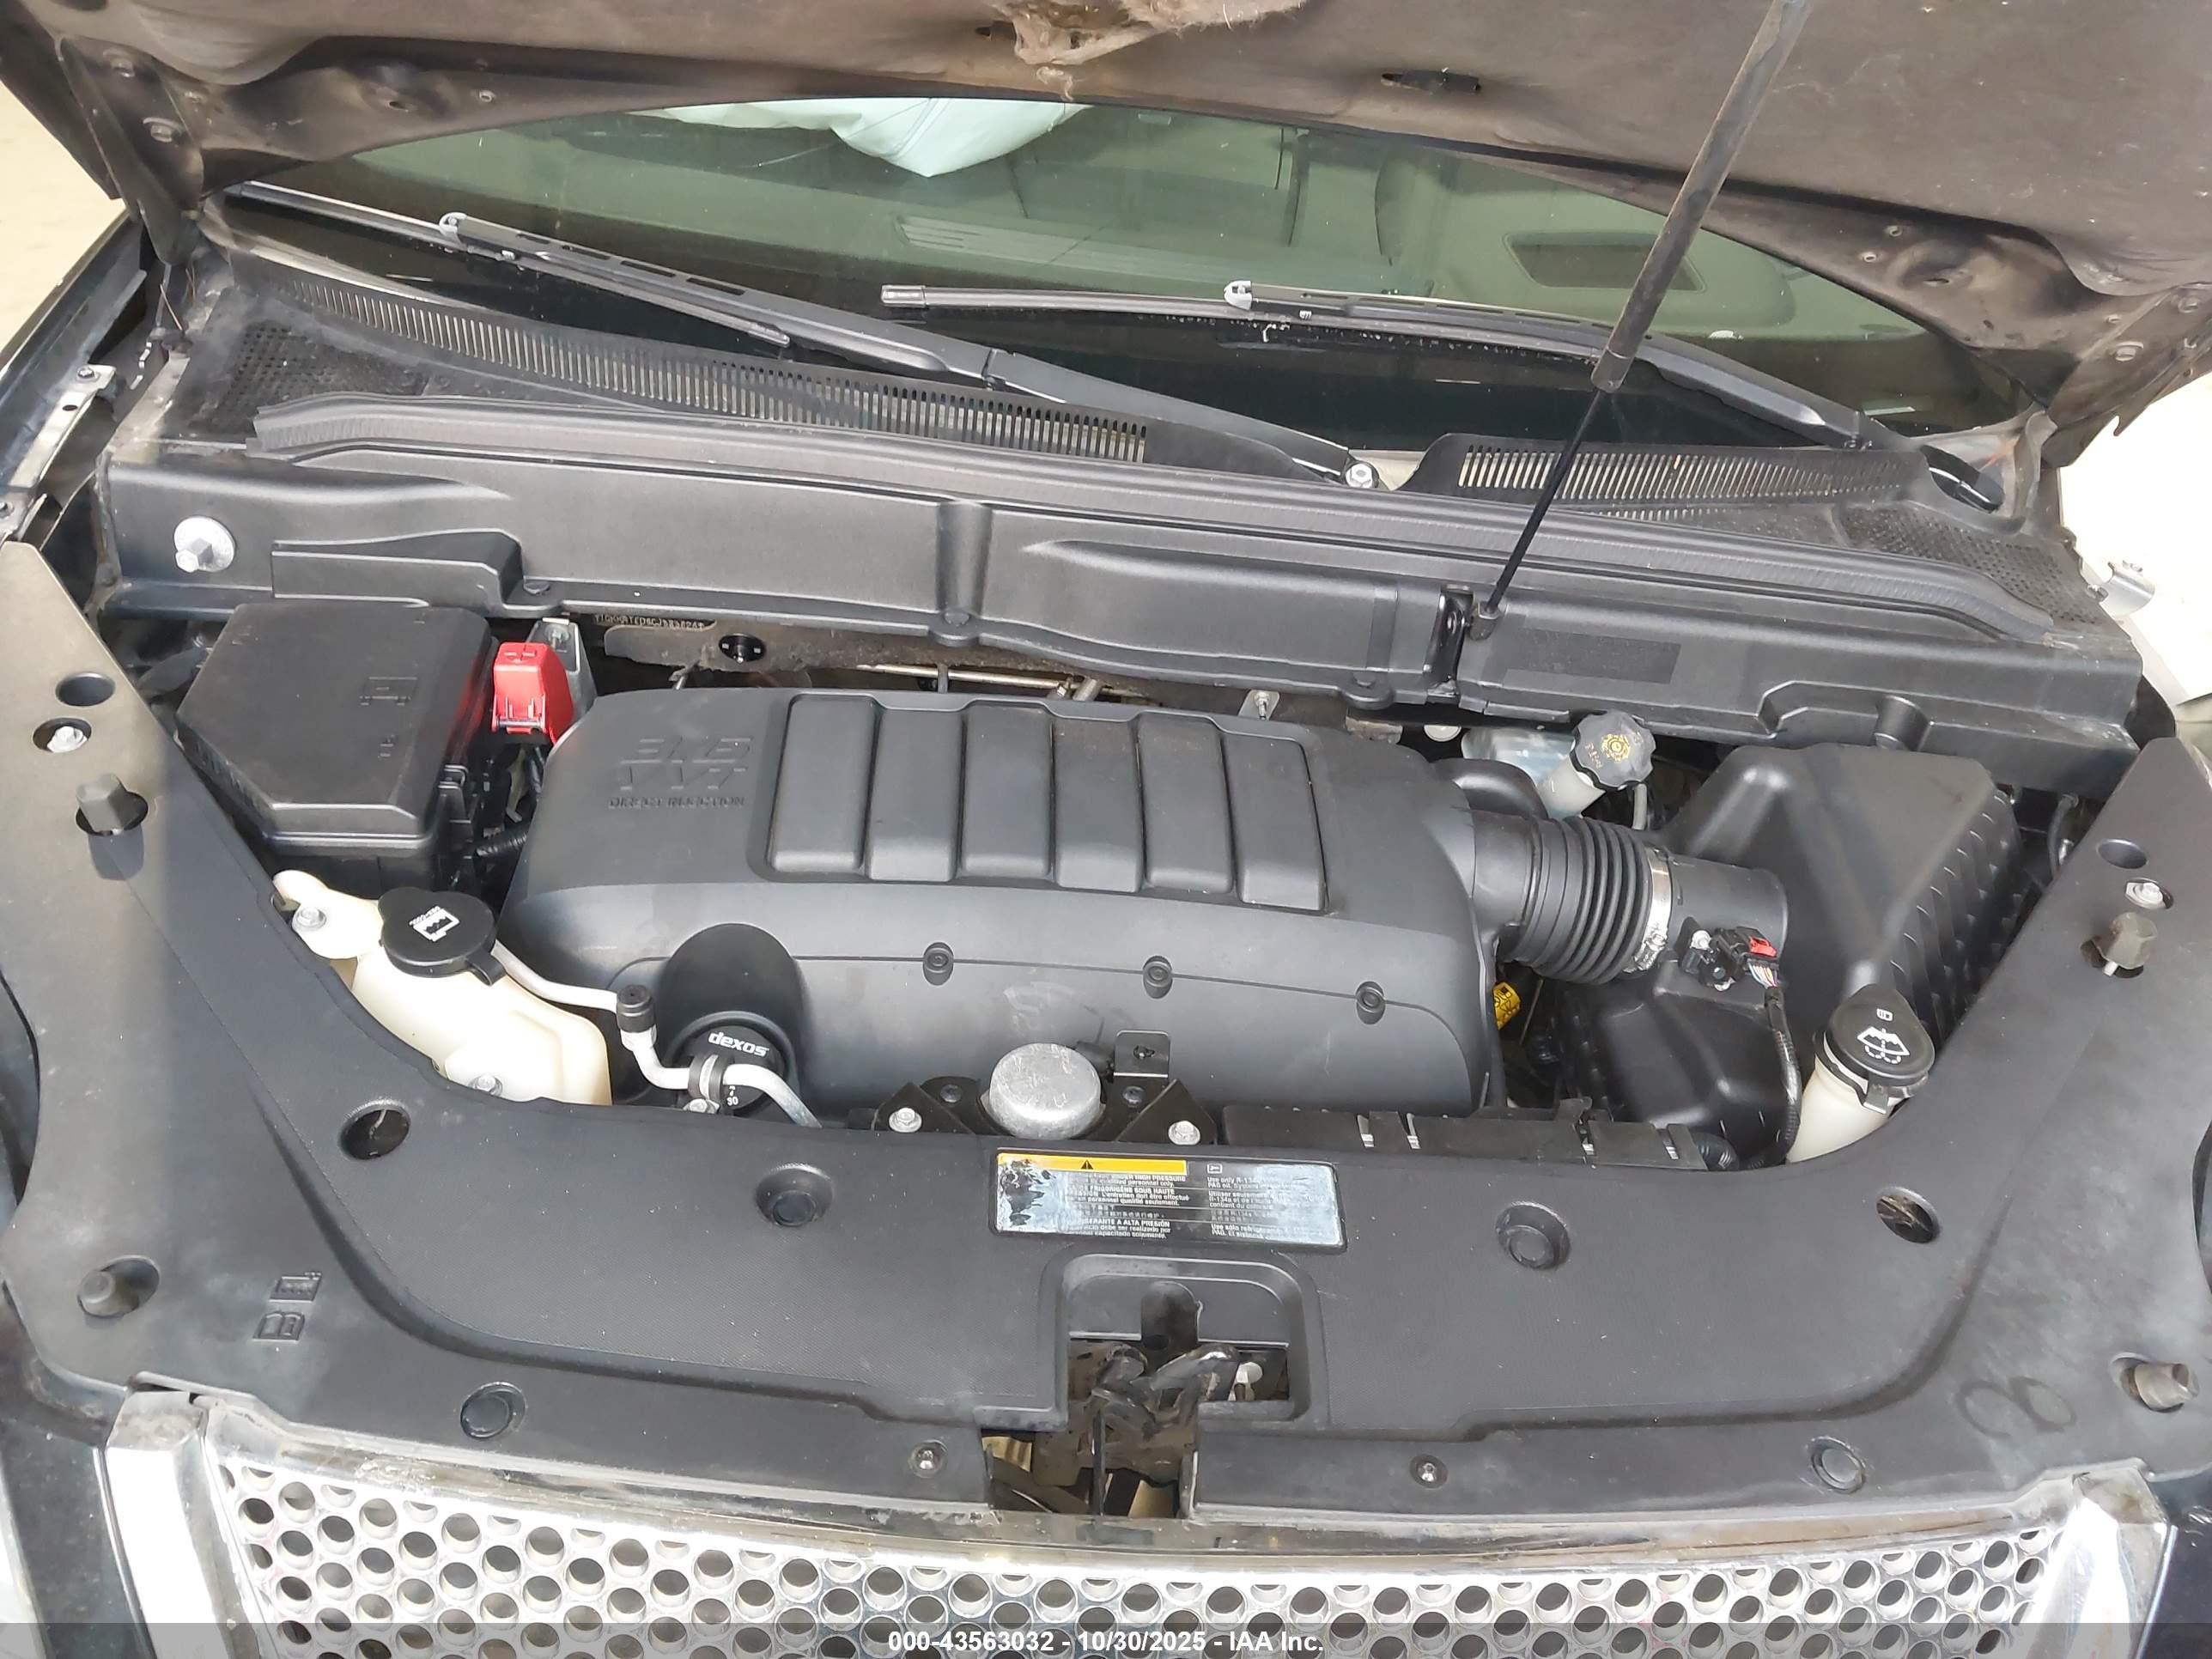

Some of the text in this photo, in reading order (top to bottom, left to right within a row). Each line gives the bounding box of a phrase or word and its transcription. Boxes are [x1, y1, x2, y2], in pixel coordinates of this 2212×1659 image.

[665, 795, 744, 810] INJECTION
[708, 1031, 769, 1057] dexos
[1141, 1219, 1170, 1228] PRESIÓN
